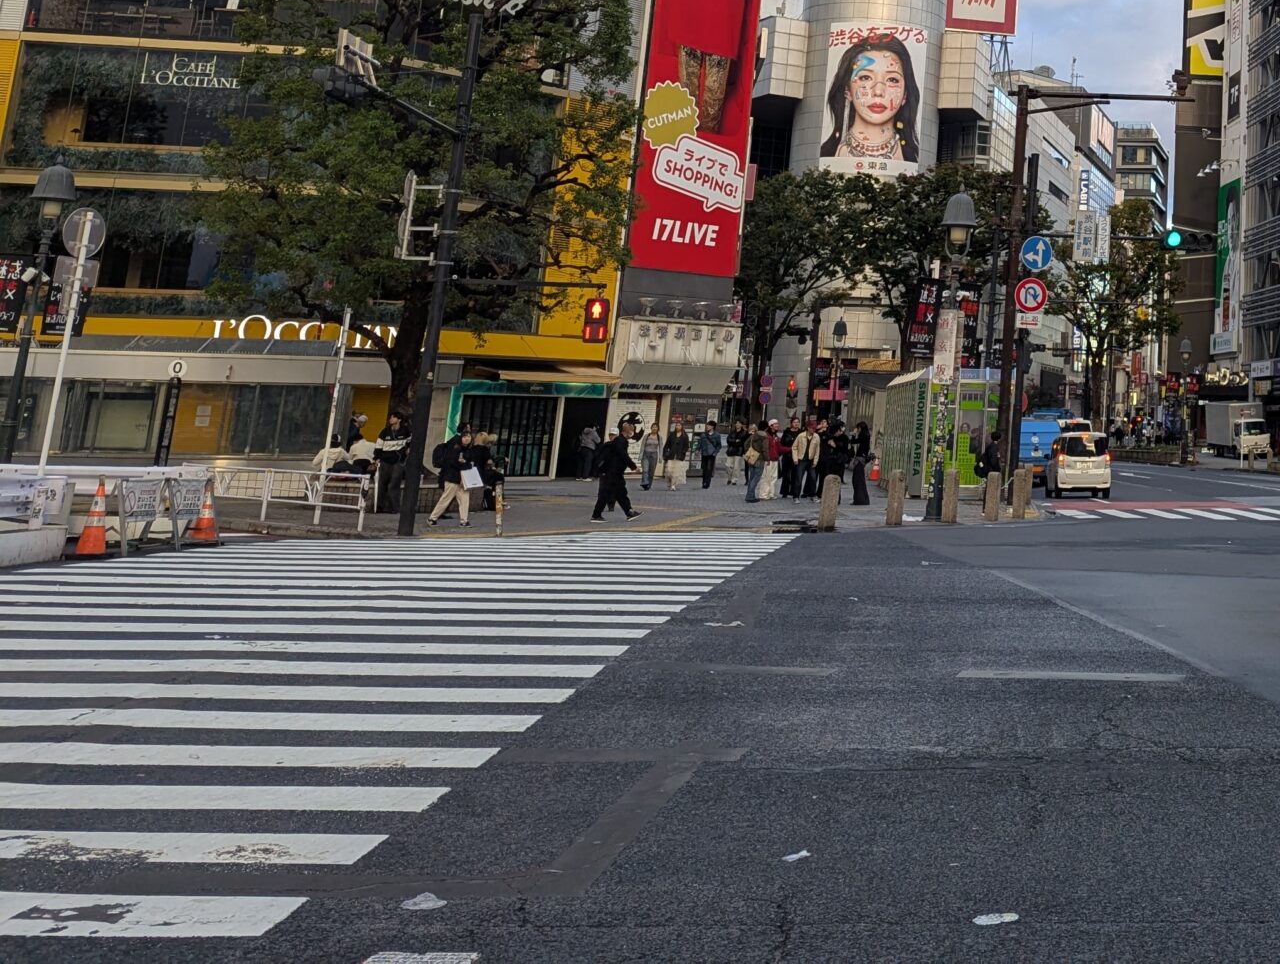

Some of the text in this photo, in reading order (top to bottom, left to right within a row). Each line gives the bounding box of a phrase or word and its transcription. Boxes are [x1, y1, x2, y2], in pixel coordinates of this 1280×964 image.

[828, 25, 928, 48] 渋谷をアゲる。
[140, 70, 240, 89] L'OCCITANE
[647, 106, 692, 129] CUTMAN
[684, 148, 730, 177] ライブで
[867, 160, 888, 172] 東急
[664, 159, 739, 200] SHOPPING!
[1079, 181, 1089, 204] LABI
[652, 217, 720, 248] 17LIVE
[1082, 214, 1093, 258] 渋谷駅前
[936, 317, 950, 377] 道玄坂
[912, 382, 926, 476] SMOKING AREA
